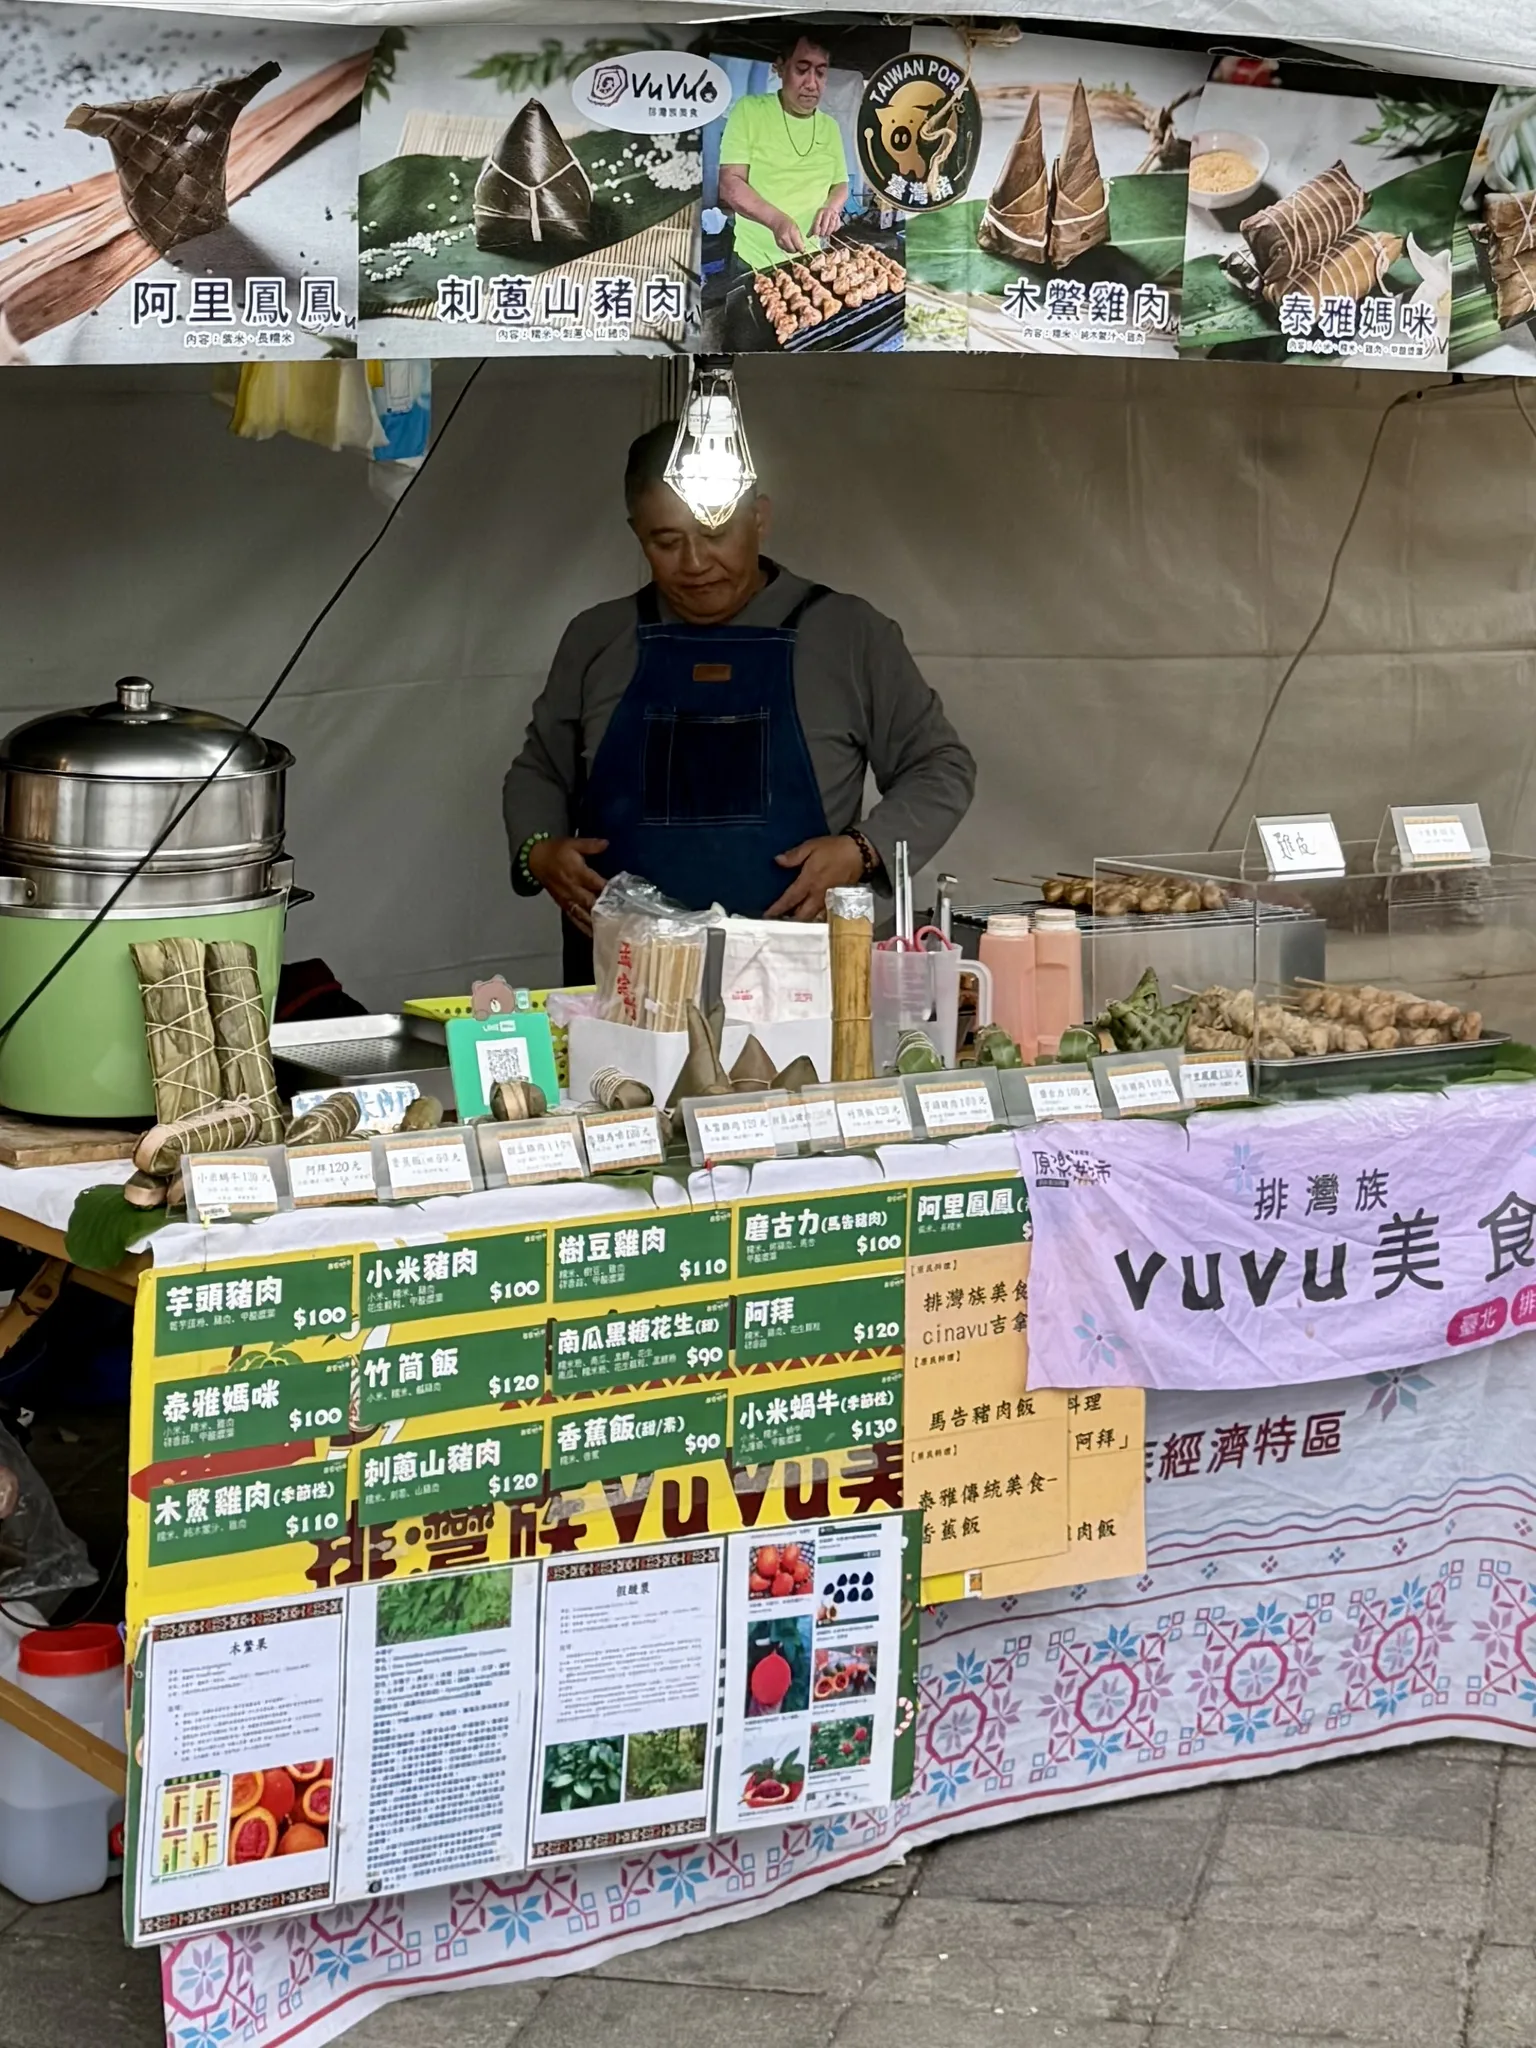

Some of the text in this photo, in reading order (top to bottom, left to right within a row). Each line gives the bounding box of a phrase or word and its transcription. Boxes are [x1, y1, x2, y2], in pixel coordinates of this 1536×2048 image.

[869, 59, 924, 104] TAIWAN
[133, 279, 342, 326] 阿里鳳鳳
[439, 277, 682, 321] 刺蔥山豬肉
[1003, 280, 1167, 326] 木鱉雞肉
[1281, 295, 1436, 339] 泰雅媽咪
[1253, 1167, 1390, 1222] 排灣族
[744, 1207, 888, 1242] 磨古力(馬告豬肉)
[558, 1225, 666, 1265] 樹豆雞肉
[856, 1234, 902, 1257] $100
[366, 1247, 478, 1288] 小米豬肉
[679, 1258, 728, 1282] $110
[166, 1275, 283, 1317] 芋頭豬肉
[489, 1280, 540, 1304] $100
[294, 1306, 347, 1331] $100
[744, 1296, 795, 1330] 阿拜
[558, 1312, 720, 1355] 南瓜黑糖花生(甜)
[853, 1321, 900, 1345] $120
[363, 1347, 459, 1388] 竹筒飯
[686, 1346, 724, 1369] $90
[162, 1378, 281, 1423] 泰雅媽咪
[488, 1374, 540, 1399] $120
[289, 1407, 343, 1432] $100
[739, 1388, 895, 1430] 小米蝸牛(季節性)
[929, 1397, 1036, 1432] 馬告豬肉飯
[557, 1412, 686, 1453] 香蕉飯(甜/素)
[684, 1432, 721, 1456] $90
[851, 1417, 898, 1441] $130
[364, 1438, 501, 1488] 刺蔥山豬肉
[153, 1480, 336, 1526] 木鱉雞肉(季節性)
[488, 1472, 539, 1498] $120
[285, 1512, 340, 1539] $110
[1067, 1518, 1117, 1542] 肉飯
